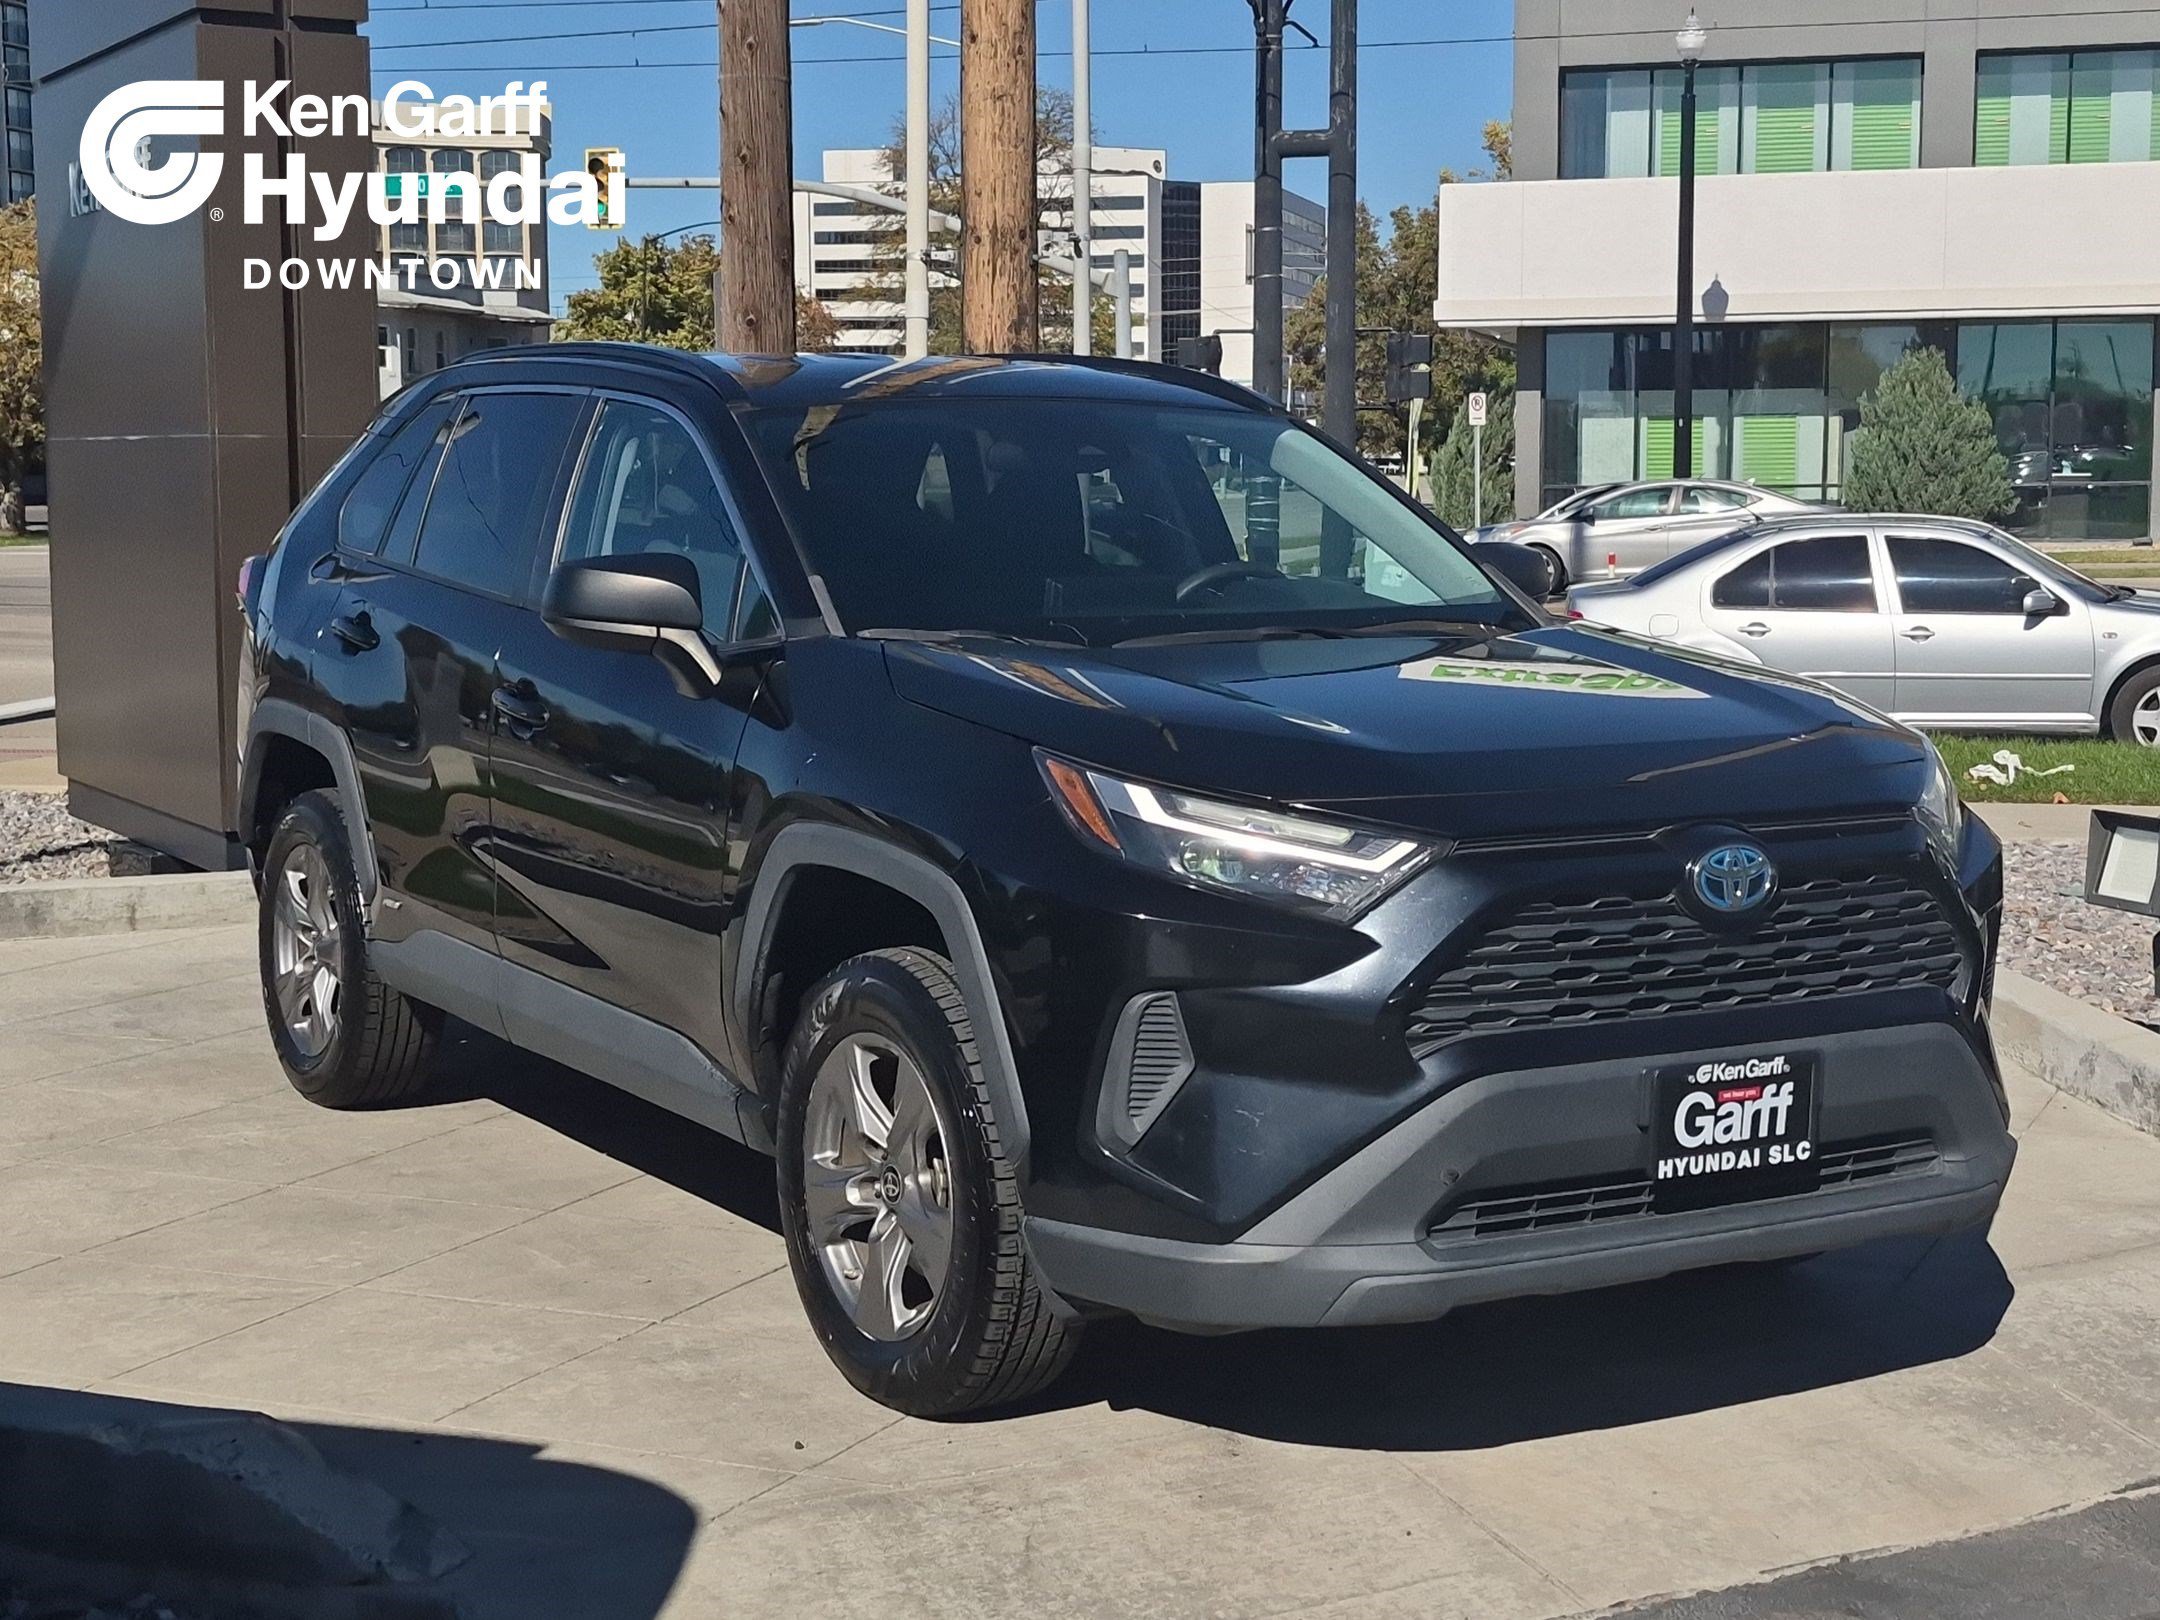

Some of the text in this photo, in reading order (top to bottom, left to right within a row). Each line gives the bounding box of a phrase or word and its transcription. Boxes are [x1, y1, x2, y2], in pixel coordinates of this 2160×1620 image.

[1712, 1055, 1785, 1083] Ken Garff
[1674, 1081, 1795, 1149] Garff
[1658, 1140, 1812, 1180] HYUNDAI SLC
